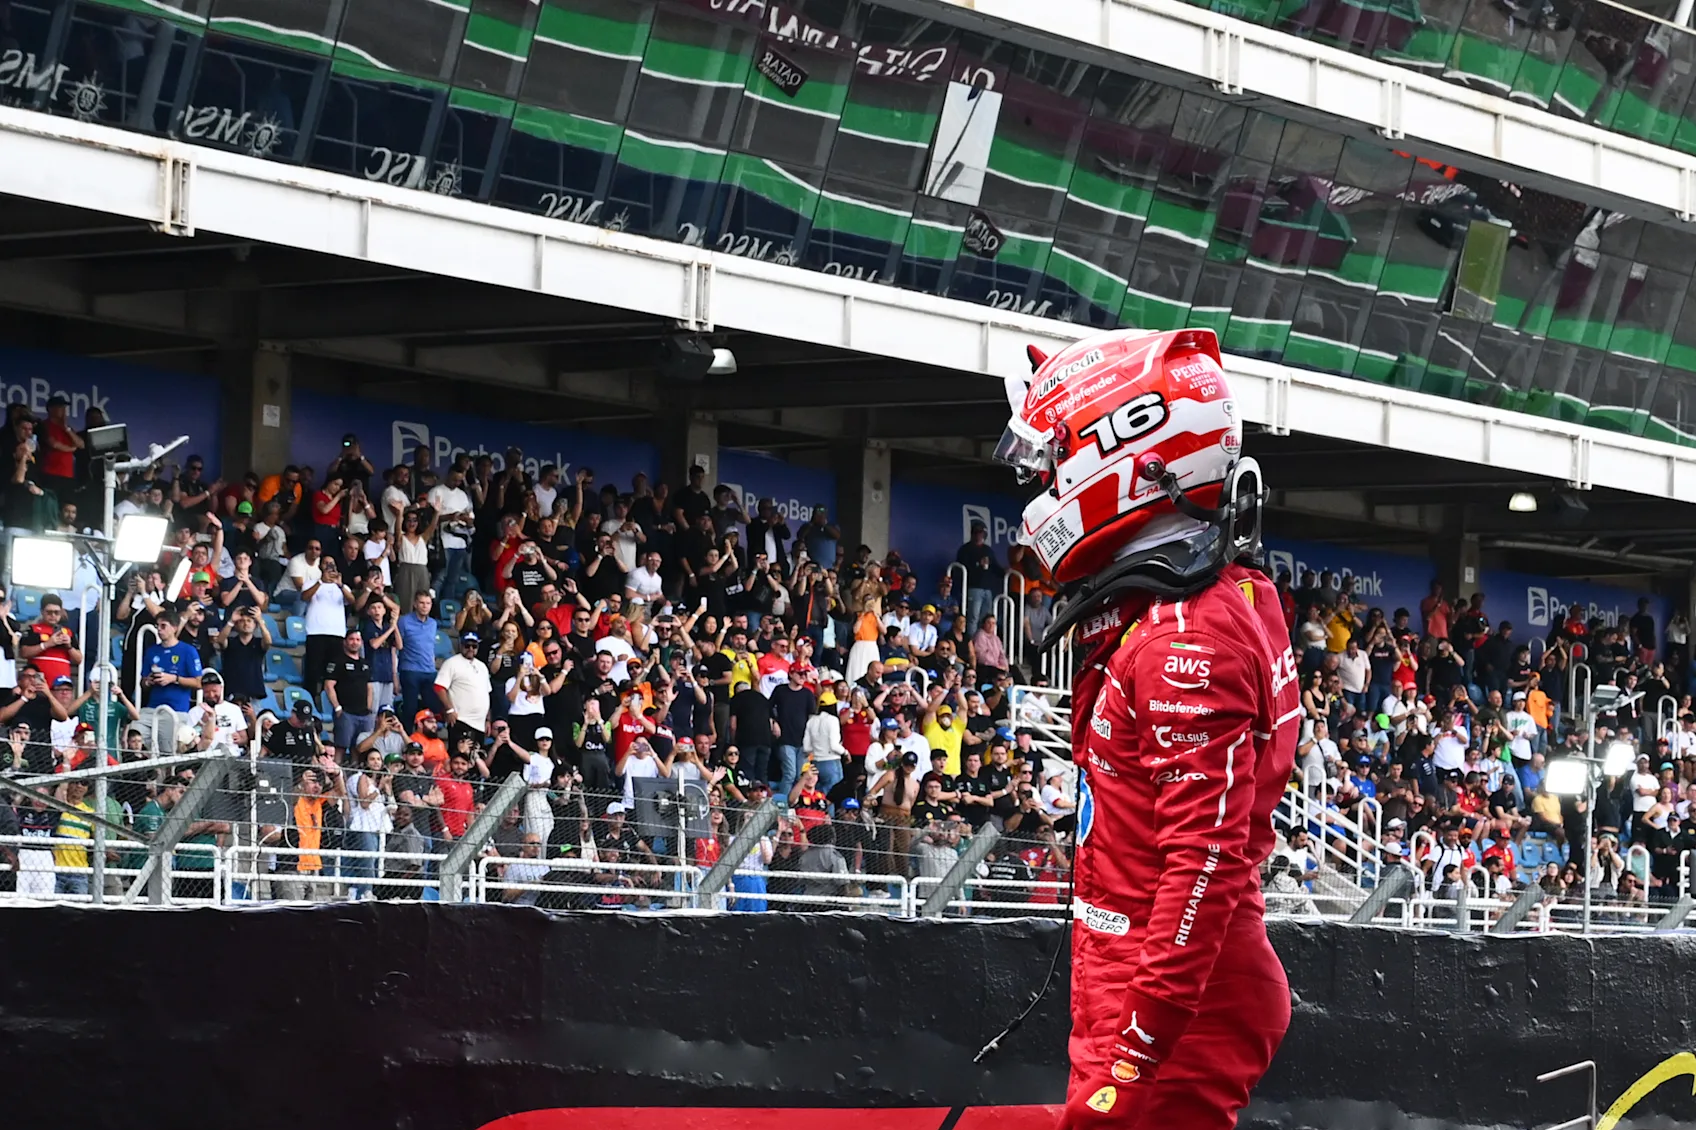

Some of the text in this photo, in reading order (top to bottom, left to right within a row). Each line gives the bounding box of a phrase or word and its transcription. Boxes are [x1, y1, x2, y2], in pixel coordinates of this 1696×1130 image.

[1037, 349, 1102, 399] UniCredit
[1055, 373, 1117, 414] Bitdefender
[1079, 391, 1171, 460] 16
[1082, 607, 1122, 640] IBM
[1164, 655, 1211, 677] aws
[1148, 699, 1215, 716] Bitdefender
[1171, 731, 1209, 743] CELSIUS
[1174, 874, 1209, 947] RICHARD
